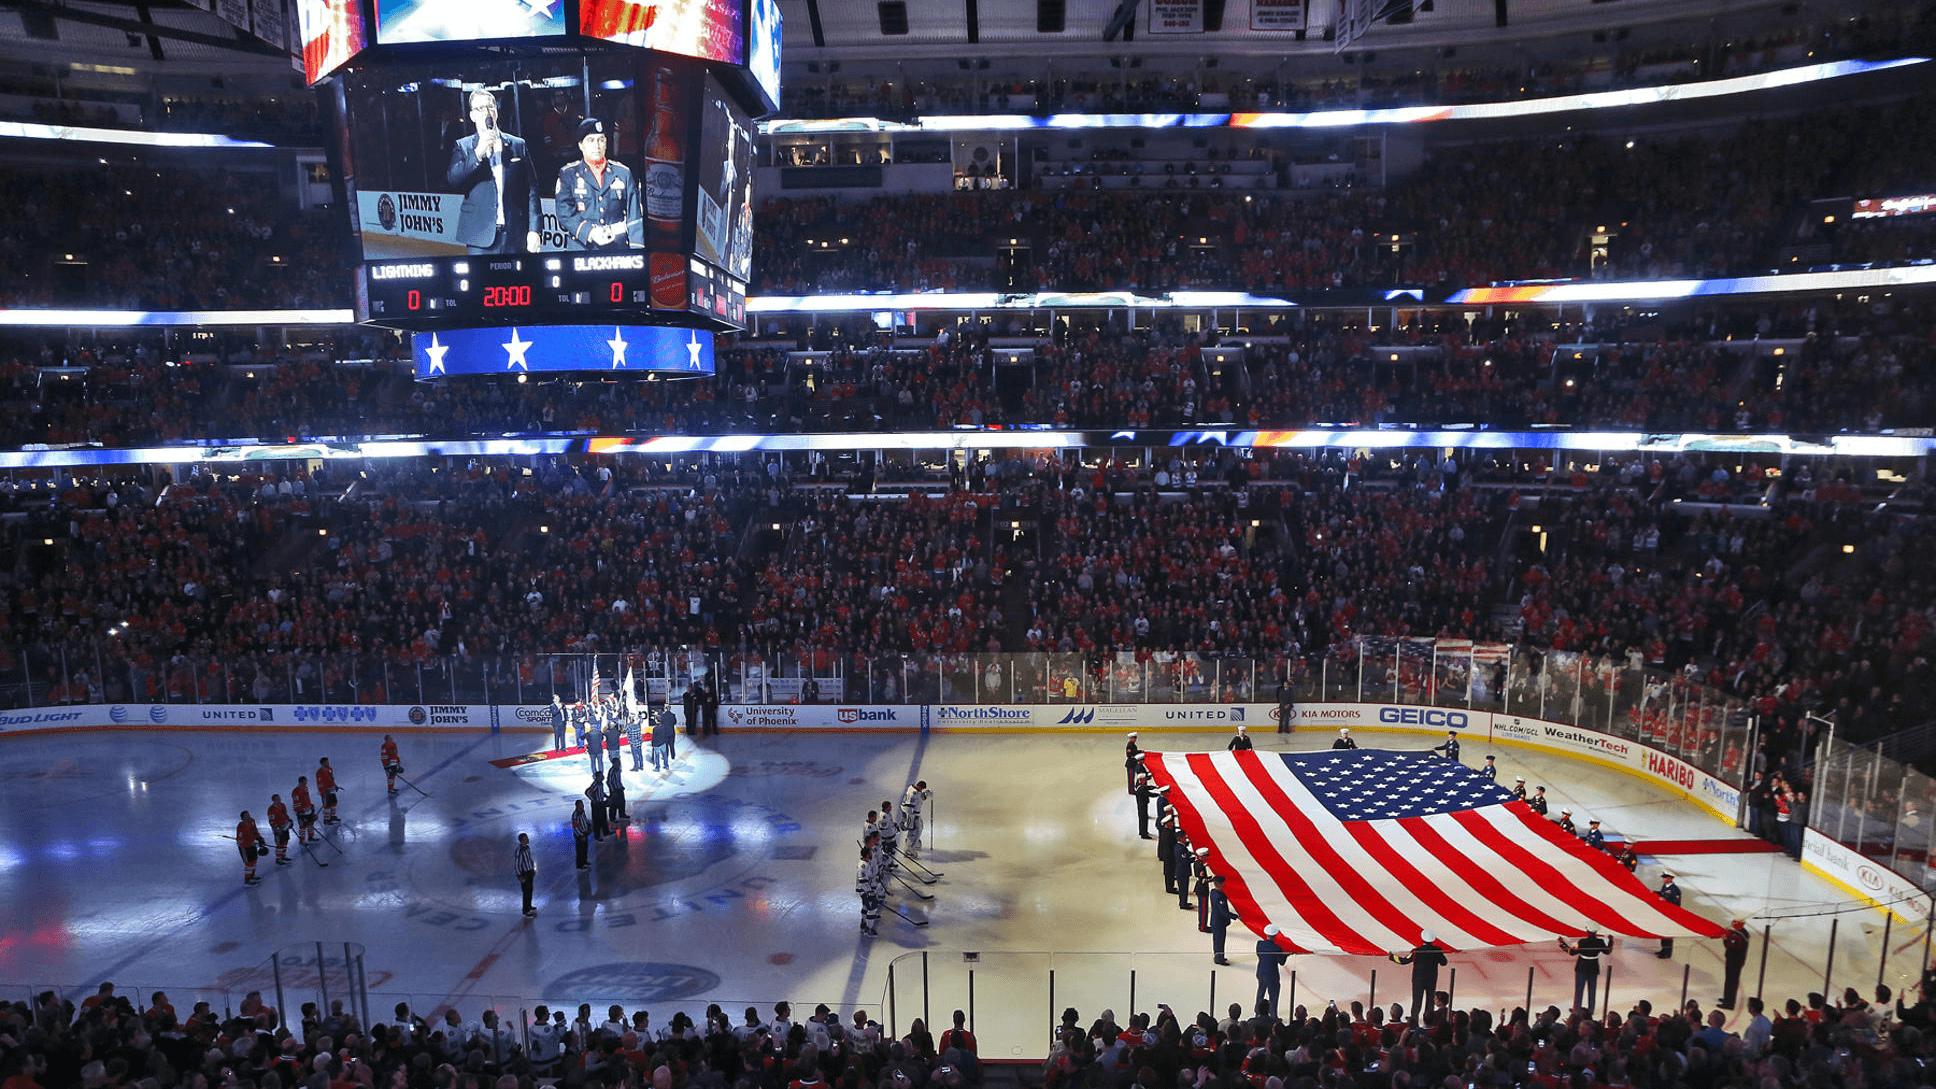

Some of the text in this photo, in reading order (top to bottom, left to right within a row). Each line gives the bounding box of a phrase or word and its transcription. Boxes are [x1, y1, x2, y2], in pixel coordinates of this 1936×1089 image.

[398, 194, 441, 213] JIMMY
[400, 213, 444, 234] JOHN'S
[490, 262, 512, 270] PERIOD
[574, 255, 644, 271] BLACKHAWKS
[372, 264, 434, 279] LIGHTNING
[483, 286, 531, 307] 20:00
[611, 282, 623, 302] 0
[408, 290, 420, 310] 0
[34, 712, 82, 723] LIGHT
[202, 711, 256, 719] UNITED
[430, 706, 467, 714] JIMMY
[746, 707, 795, 717] University
[948, 707, 1030, 719] NorthShore
[1166, 711, 1226, 719] UNITED
[1302, 710, 1317, 718] KIA
[1320, 710, 1360, 718] MOTORS
[1380, 707, 1468, 728] GEICO
[431, 715, 468, 725] JOHN'S
[747, 717, 797, 725] of Phoenix
[1544, 727, 1628, 754] WeatherTech
[1649, 752, 1695, 790] HARIBO
[1861, 869, 1880, 888] KIA
